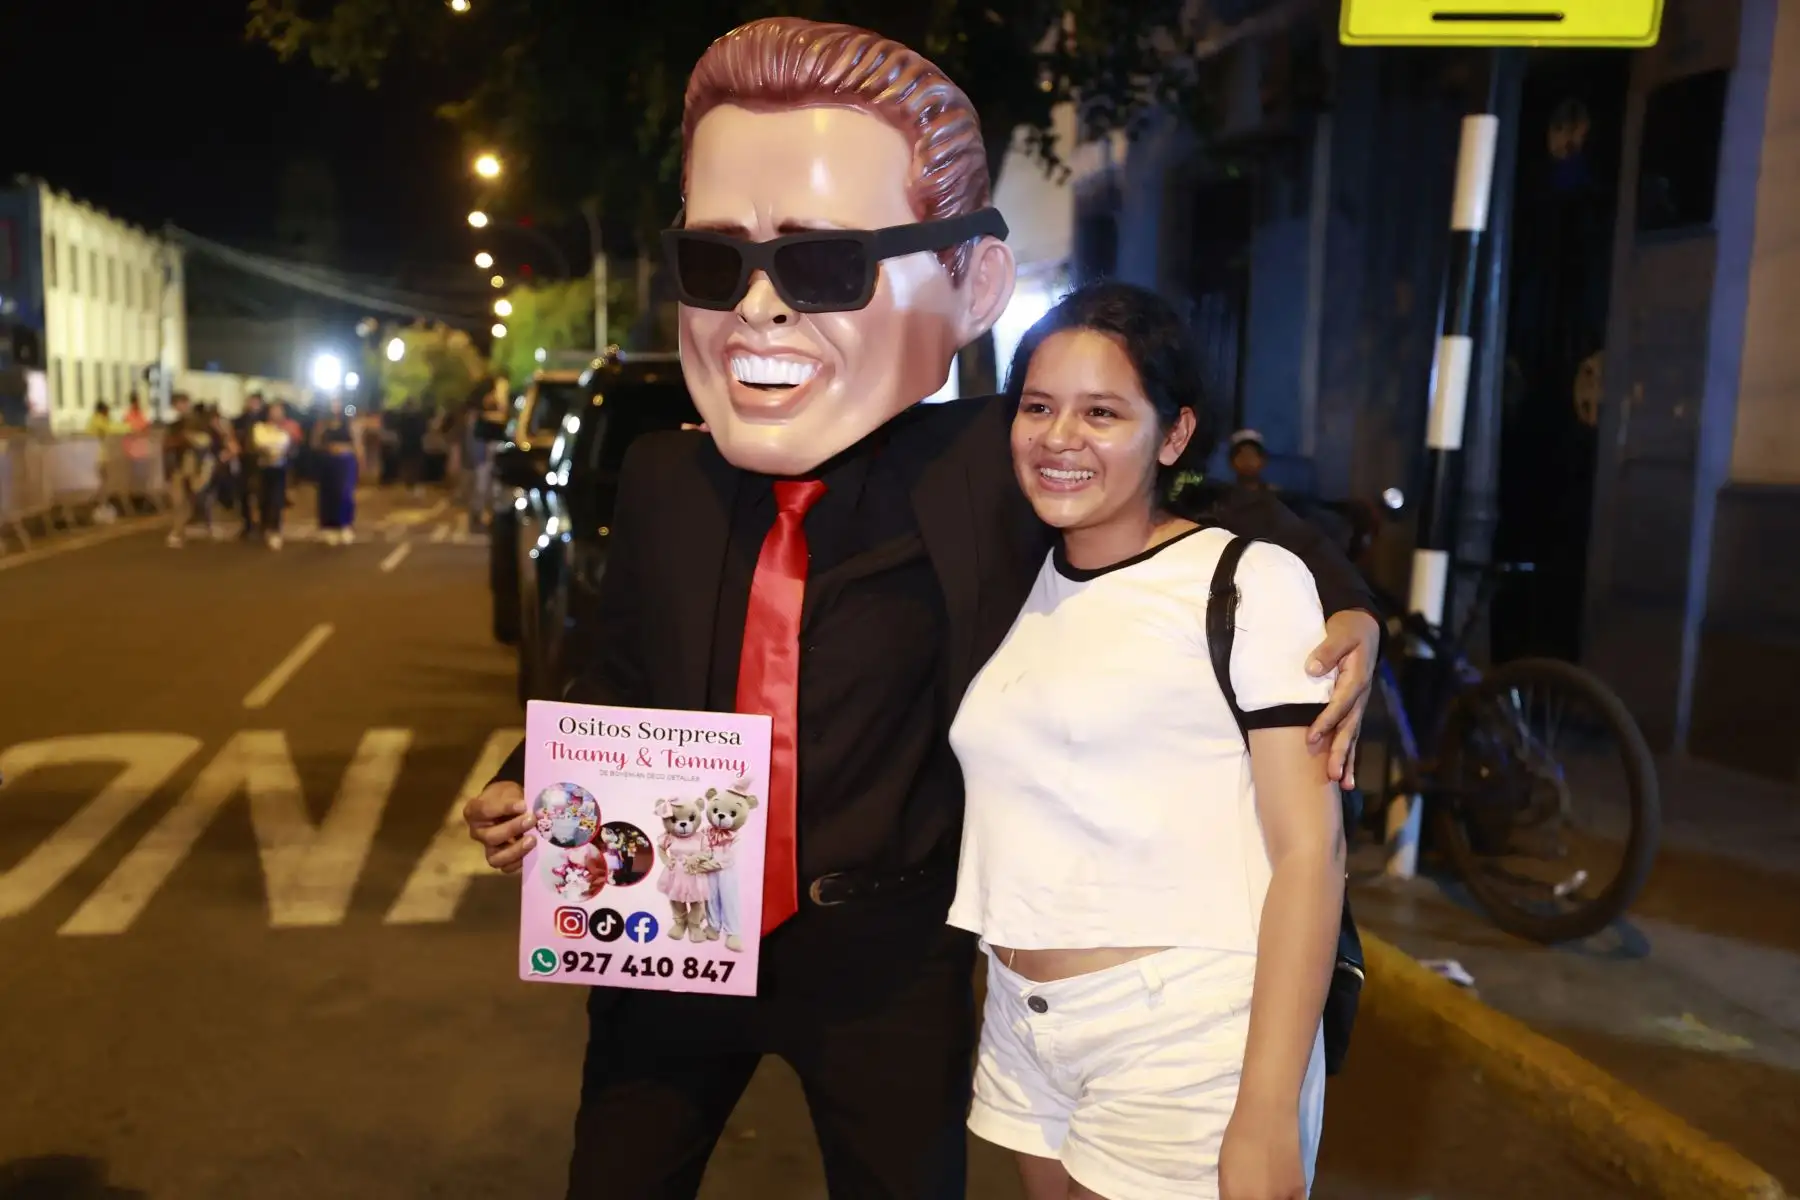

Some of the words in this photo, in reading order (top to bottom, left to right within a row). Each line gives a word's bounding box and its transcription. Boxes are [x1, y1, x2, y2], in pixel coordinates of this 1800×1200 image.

[559, 716, 631, 739] Ositos
[638, 721, 742, 747] Sorpresa
[545, 740, 629, 771] Thamy
[636, 747, 652, 768] &
[661, 748, 749, 778] Tommy
[563, 950, 613, 975] 927
[621, 955, 674, 978] 410
[682, 956, 736, 983] 847
